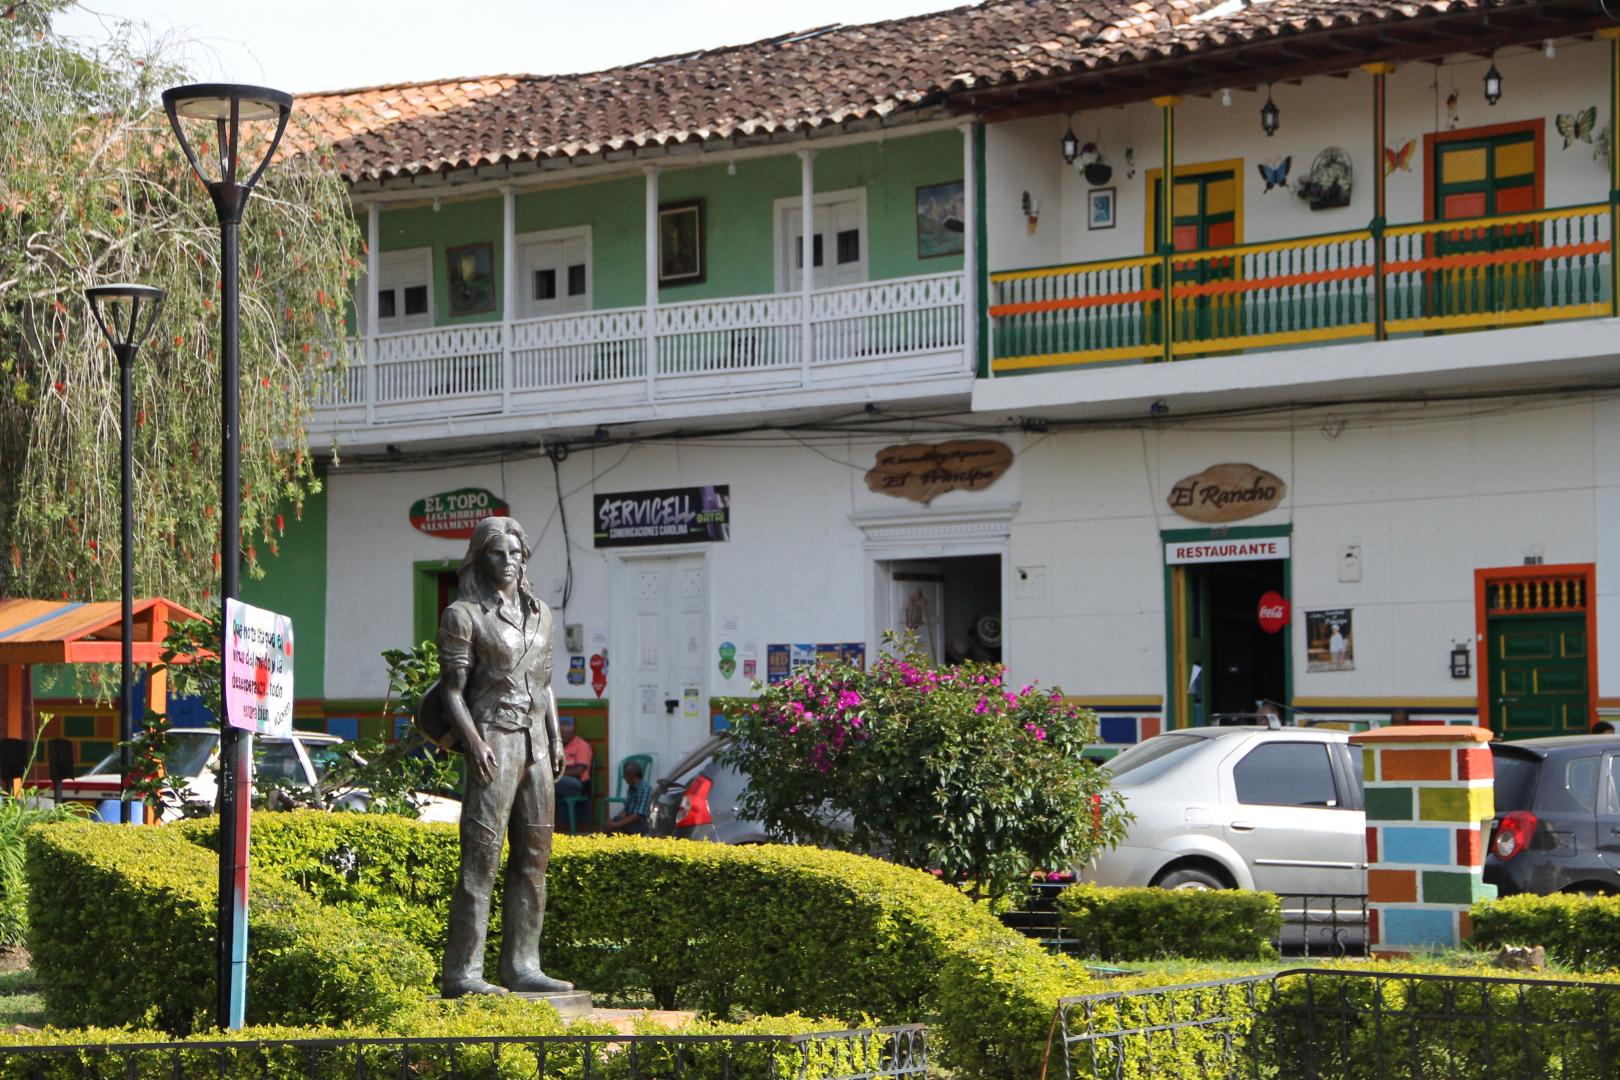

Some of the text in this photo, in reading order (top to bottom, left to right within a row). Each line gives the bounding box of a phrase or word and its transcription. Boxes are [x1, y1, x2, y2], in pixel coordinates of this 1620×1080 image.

[1171, 476, 1277, 509] El Rancho
[424, 492, 489, 513] EL TOPO
[598, 495, 697, 531] SERVICELL
[609, 523, 689, 539] COMUNICACIONES CAROLINA
[1176, 542, 1277, 559] RESTAURANTE
[233, 619, 243, 639] Que
[277, 633, 284, 652] el
[271, 660, 276, 674] y
[277, 656, 283, 673] la
[269, 683, 283, 698] todo
